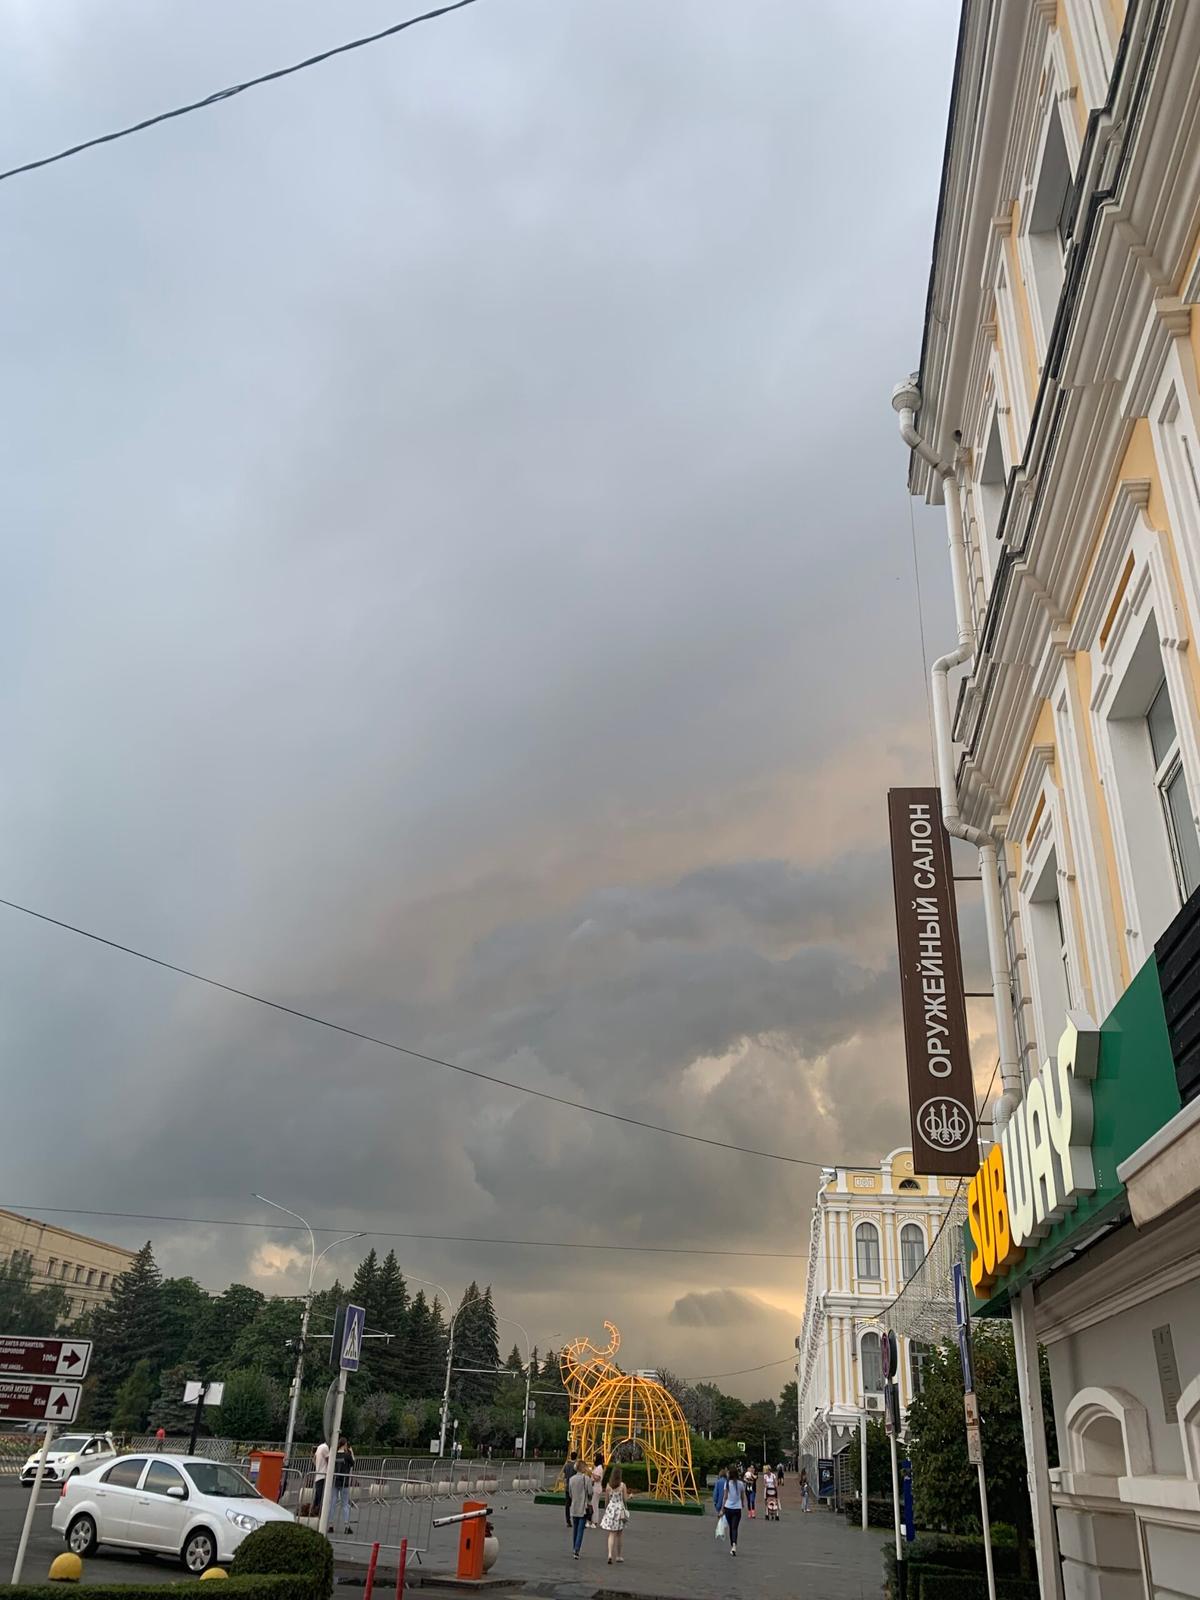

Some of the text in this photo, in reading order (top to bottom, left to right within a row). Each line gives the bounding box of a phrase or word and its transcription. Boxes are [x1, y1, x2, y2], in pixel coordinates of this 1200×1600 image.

[909, 804, 952, 1078] ОРУЖЕЙНЫЙ САЛОН
[968, 1010, 1080, 1299] SUBWAY
[14, 1385, 34, 1394] МУЗЕЙ
